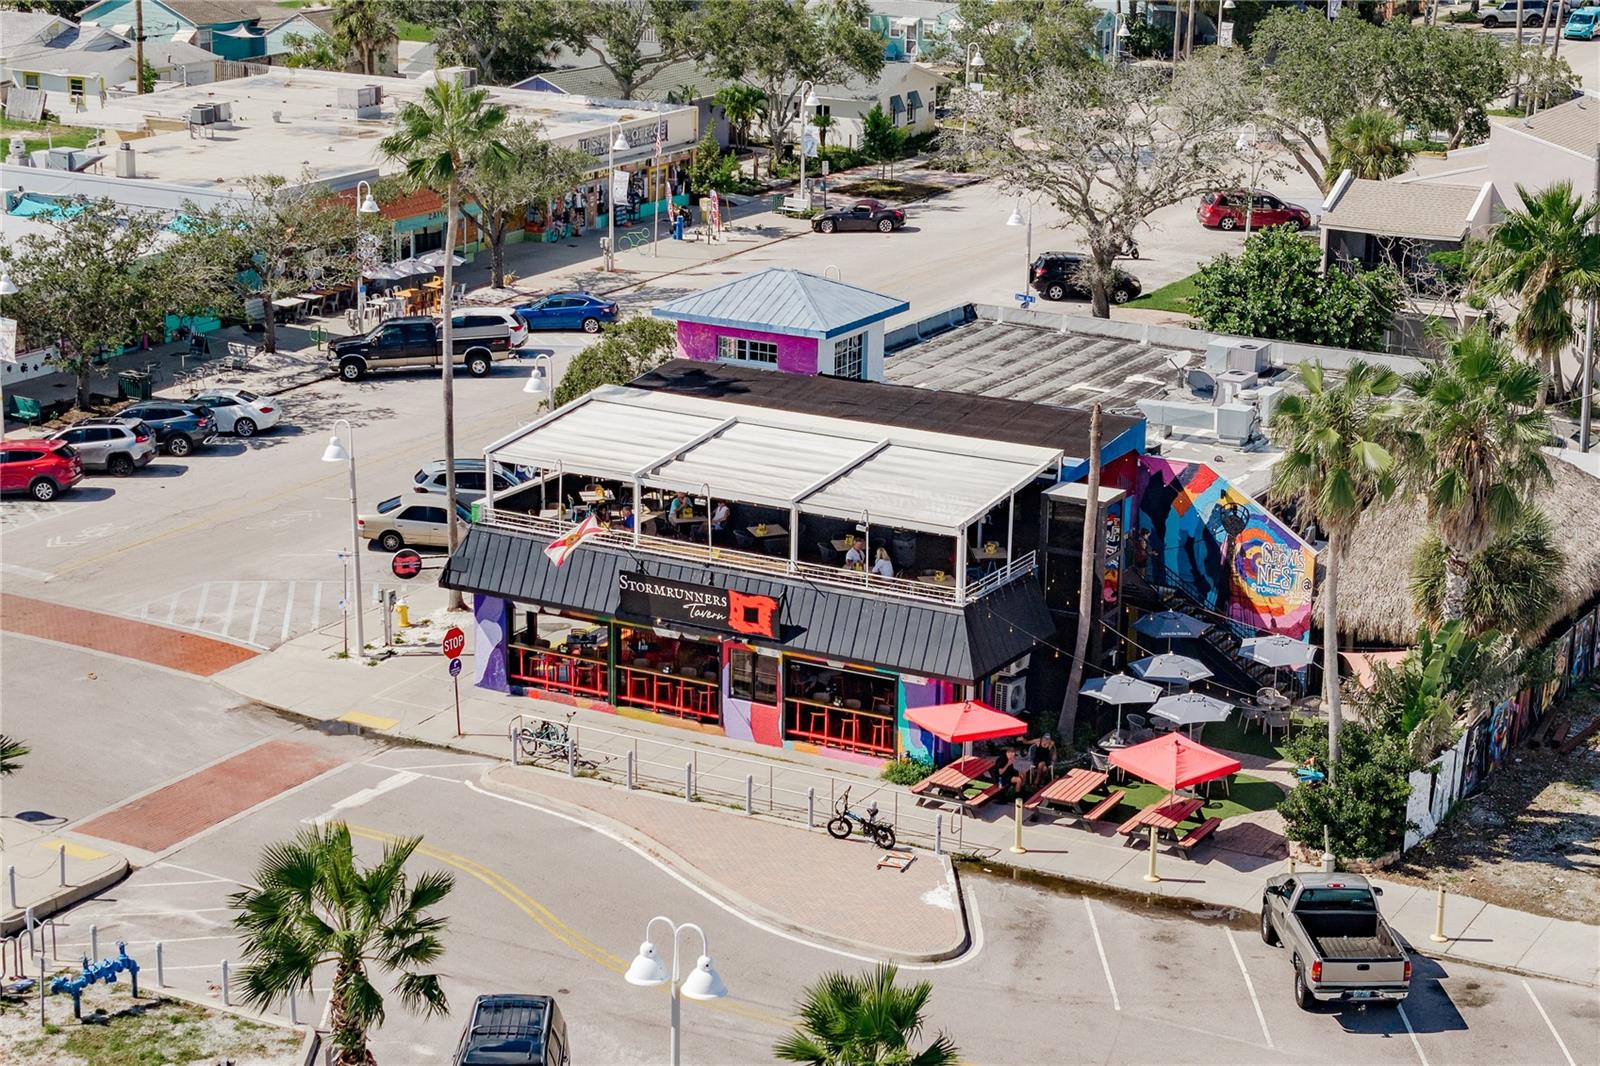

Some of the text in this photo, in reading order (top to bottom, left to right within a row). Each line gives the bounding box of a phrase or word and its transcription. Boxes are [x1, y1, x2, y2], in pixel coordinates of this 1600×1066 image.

[1257, 564, 1305, 592] NEST
[619, 574, 727, 607] STORMRUNNERS
[683, 602, 727, 620] Tavern
[444, 635, 464, 652] STOP
